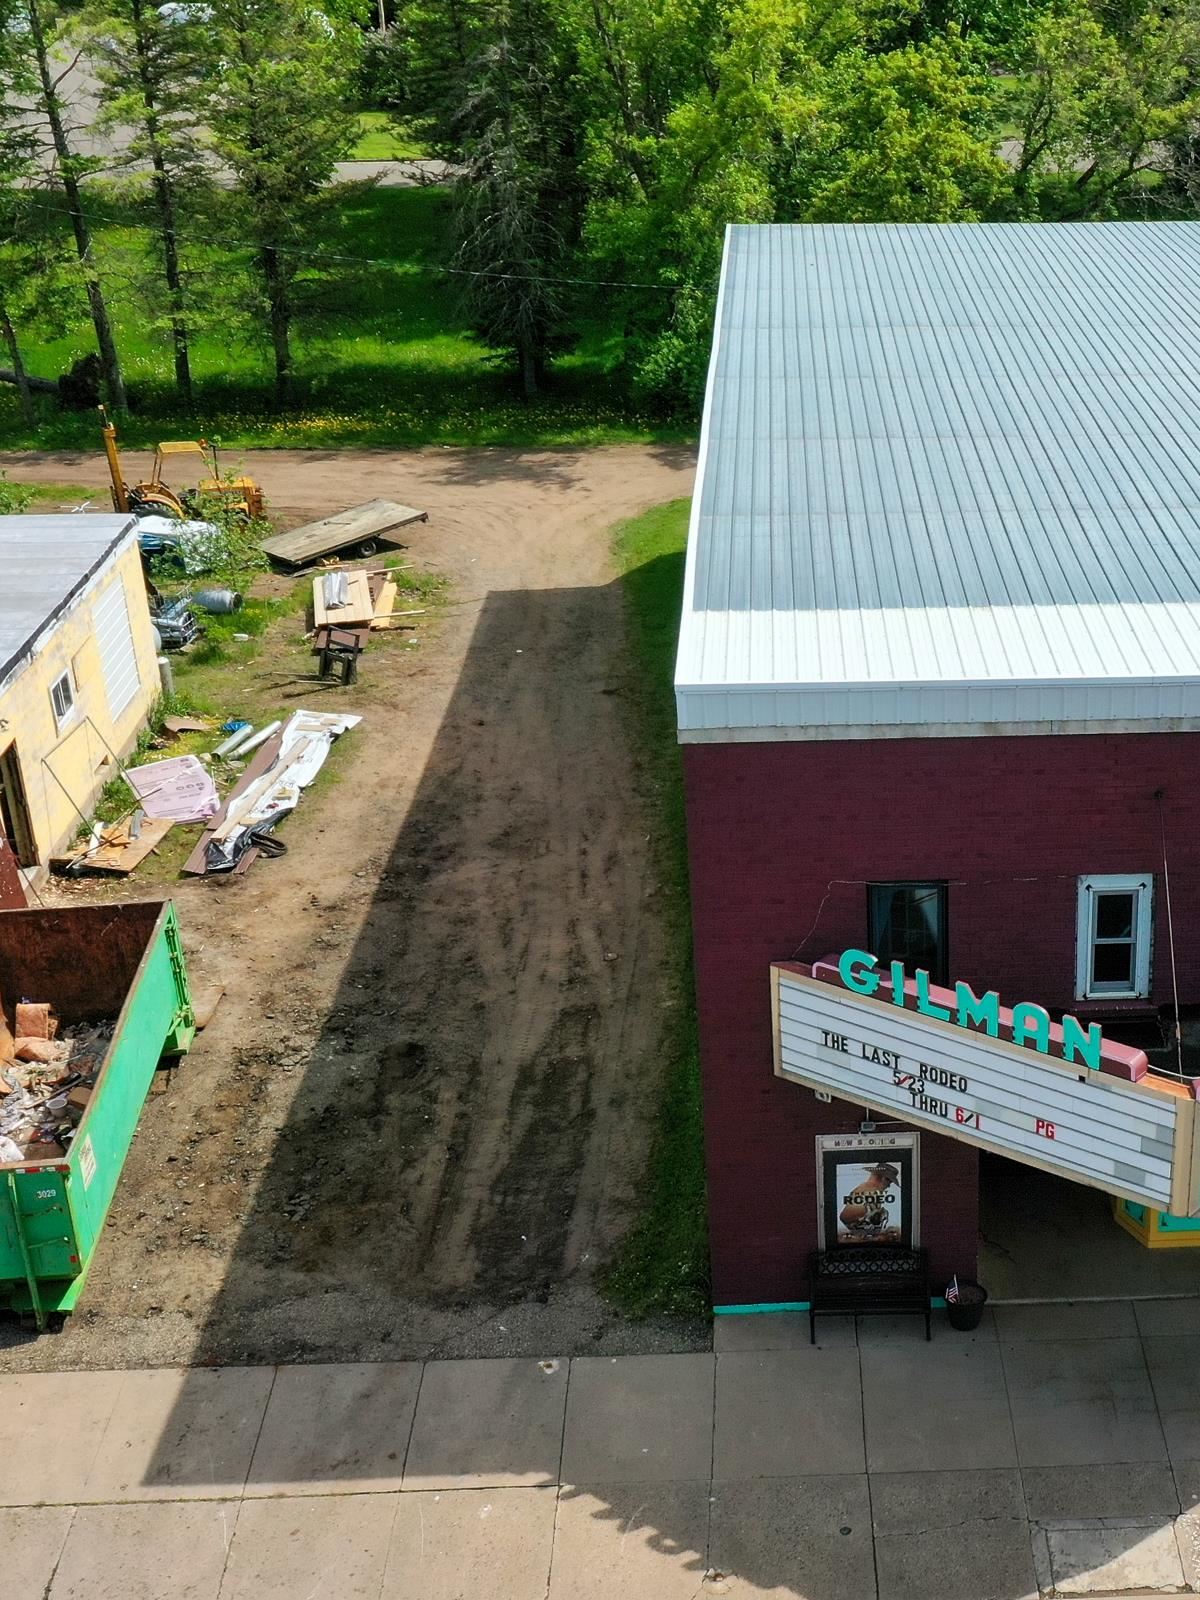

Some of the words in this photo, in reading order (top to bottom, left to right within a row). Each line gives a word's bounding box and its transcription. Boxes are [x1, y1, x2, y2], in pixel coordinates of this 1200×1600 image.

[839, 948, 1102, 1070] GILMAN
[821, 1030, 849, 1053] THE
[862, 1044, 900, 1070] LAST
[919, 1062, 968, 1093] RODEO
[892, 1070, 925, 1094] 5/23
[909, 1091, 949, 1118] THRU
[955, 1107, 980, 1130] 6/1
[1036, 1119, 1055, 1140] PG
[37, 1189, 57, 1198] 3029
[843, 1194, 896, 1205] RODEO
